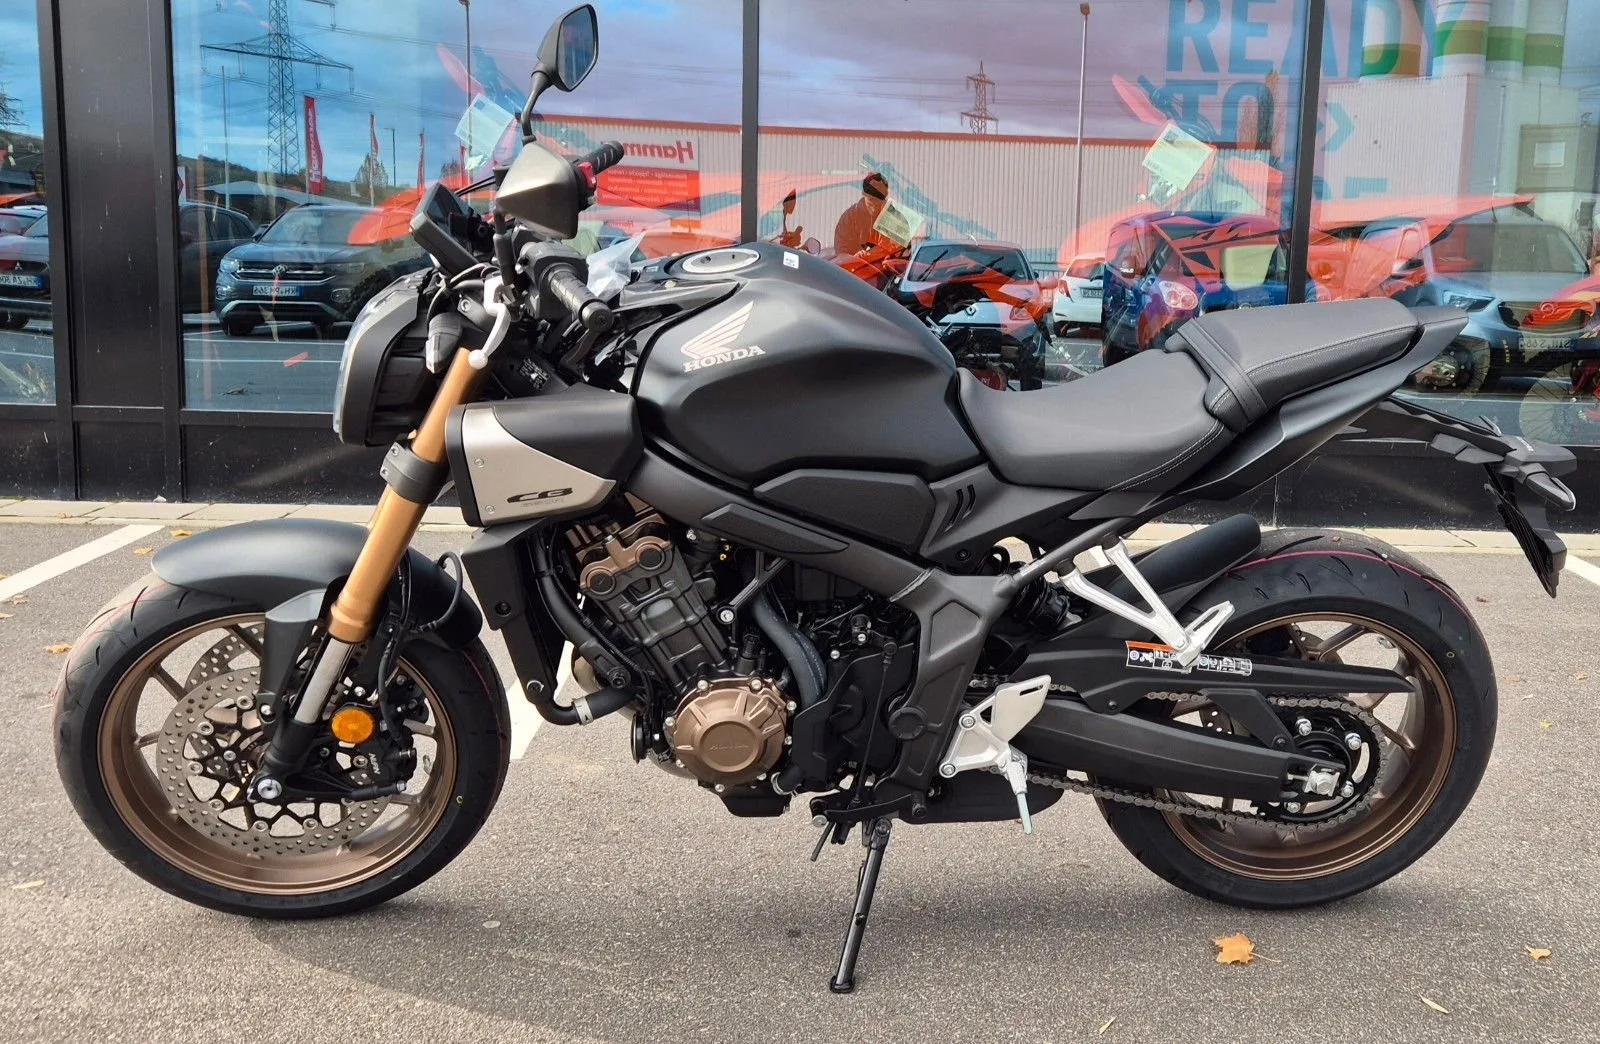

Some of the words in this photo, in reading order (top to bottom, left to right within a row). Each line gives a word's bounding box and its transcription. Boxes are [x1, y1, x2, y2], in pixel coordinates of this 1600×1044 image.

[1166, 0, 1469, 78] READY
[683, 345, 766, 373] HONDA
[507, 488, 573, 503] CB
